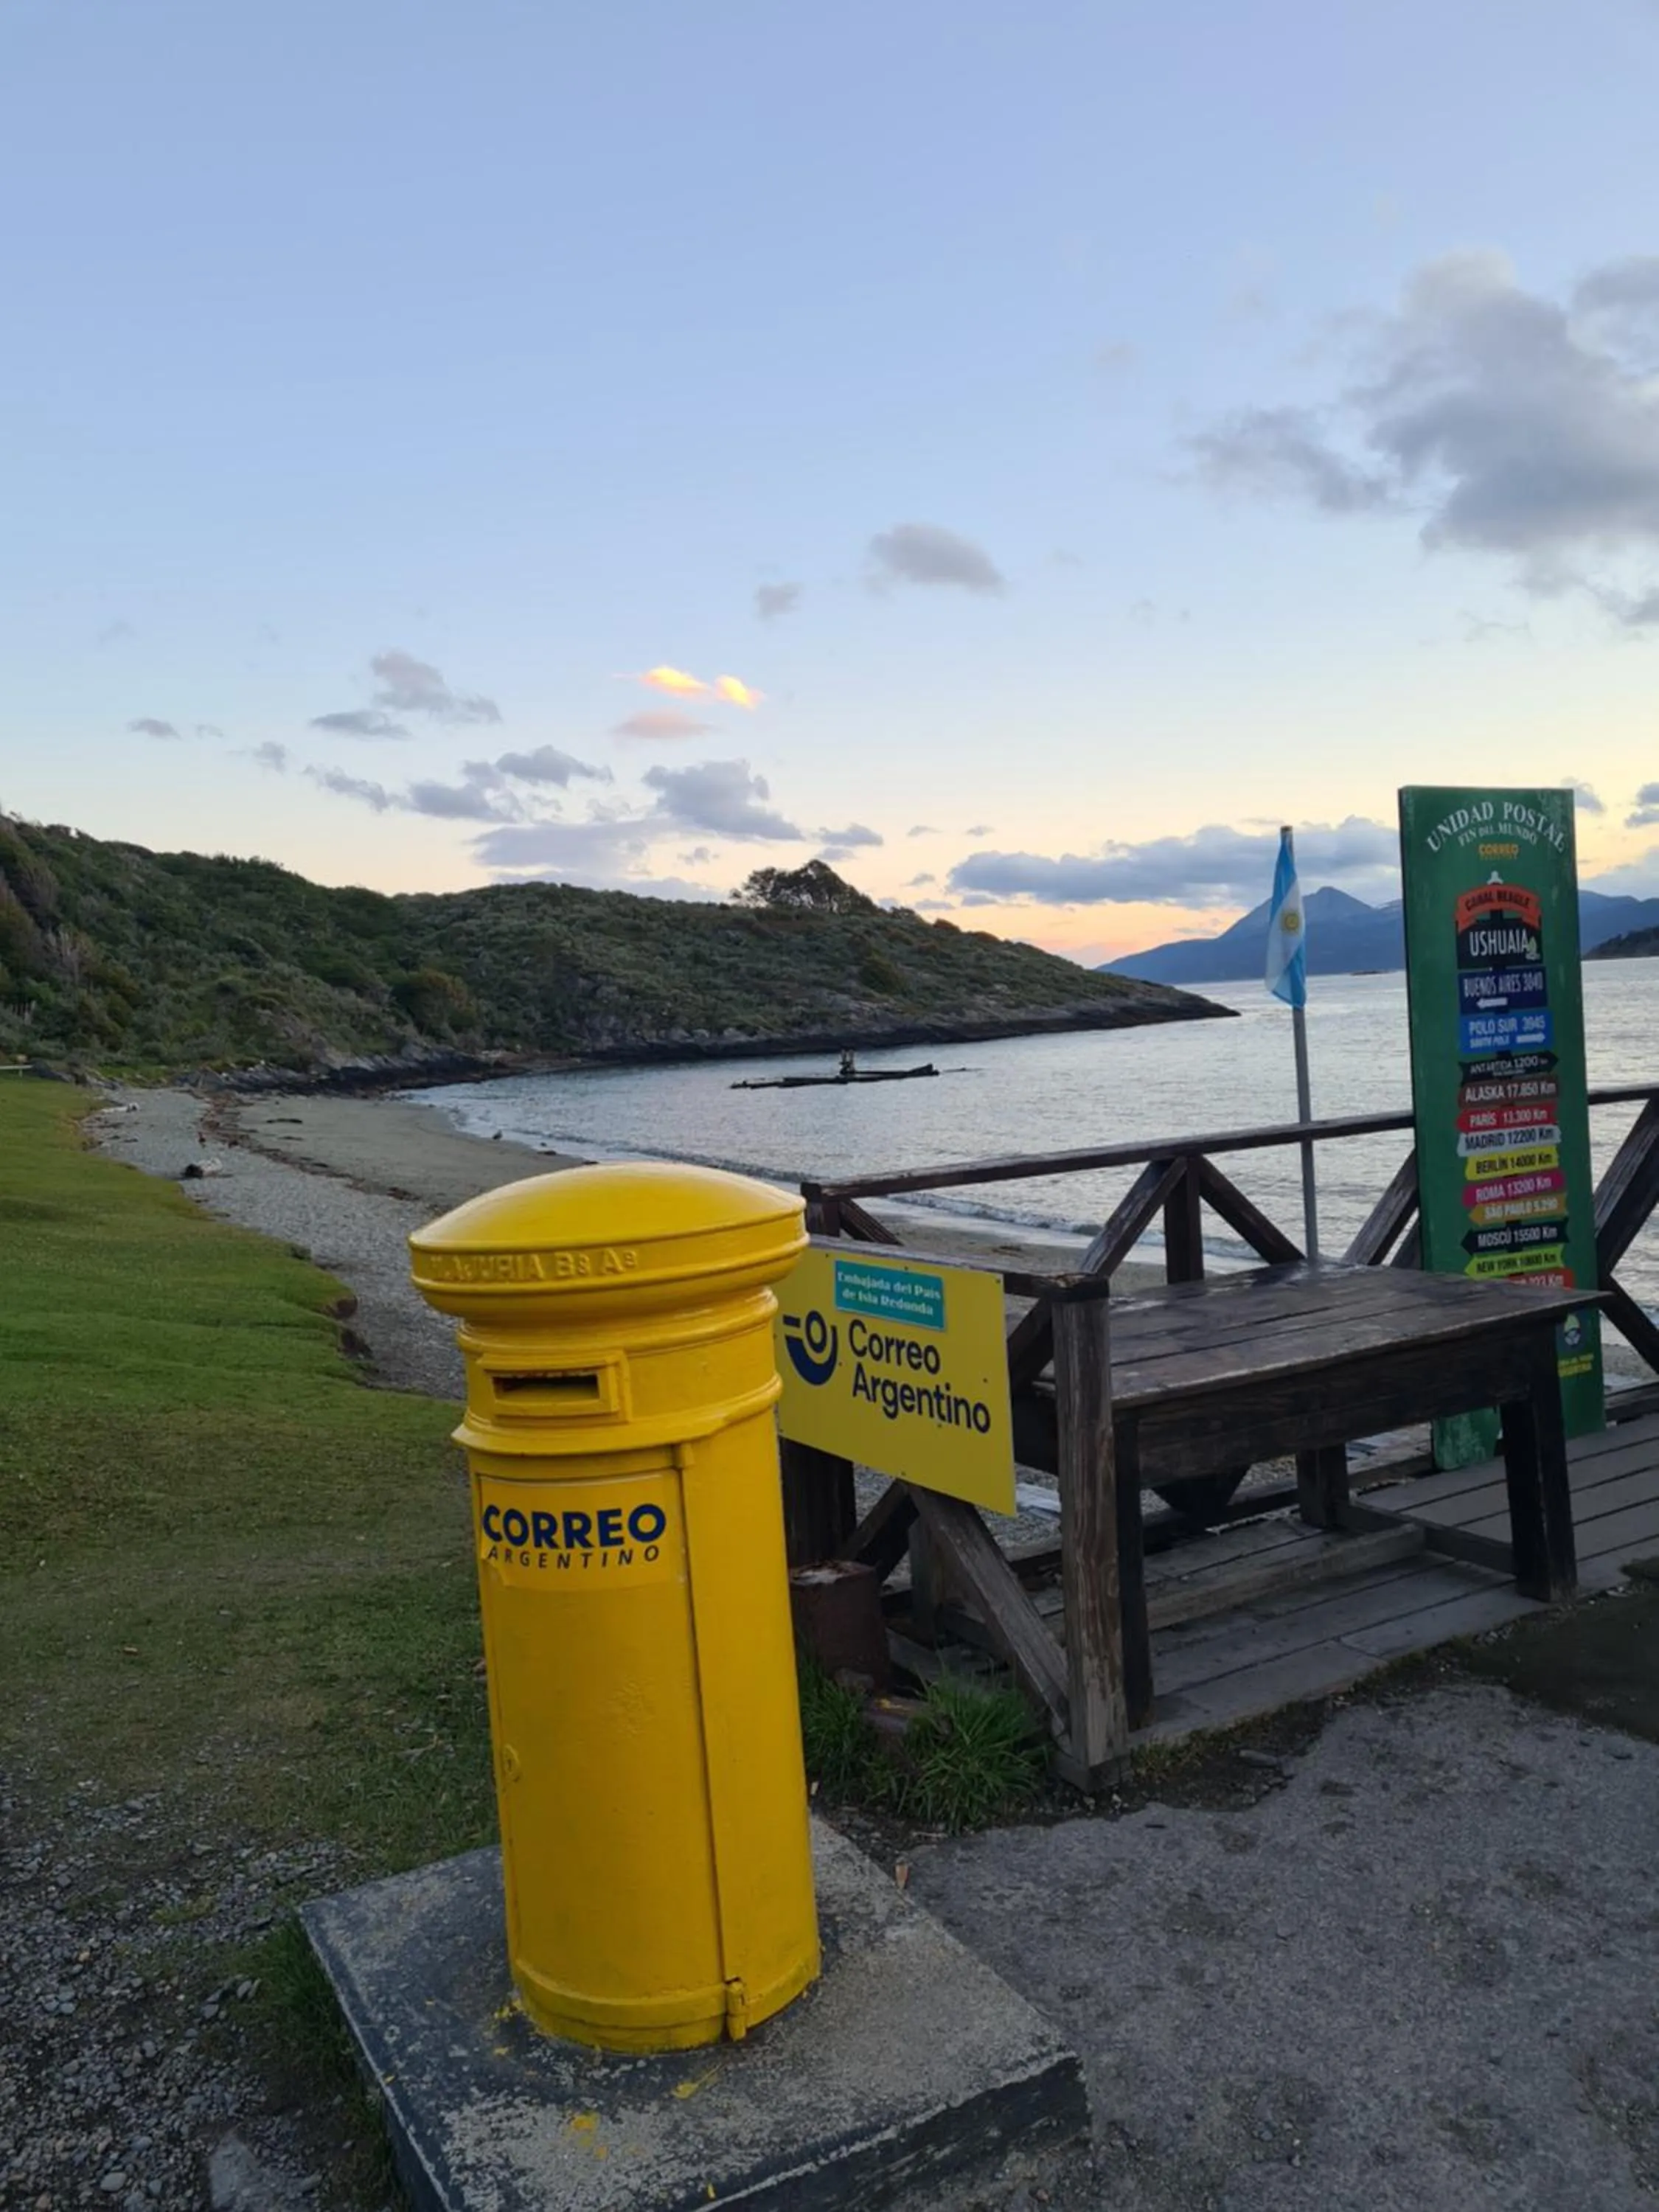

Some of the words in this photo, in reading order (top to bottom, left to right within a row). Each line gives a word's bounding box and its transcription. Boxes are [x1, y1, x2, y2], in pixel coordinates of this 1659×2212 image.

[1427, 801, 1494, 852] UNIDAD
[1503, 801, 1565, 853] POSTAL
[1498, 822, 1537, 846] MUNDO
[1469, 928, 1529, 957] USHUAIA
[1463, 975, 1497, 998] BUENOS
[1498, 973, 1521, 995] AIRES
[1469, 1018, 1496, 1037] POLO
[1497, 1016, 1518, 1034] SUR
[1465, 1084, 1506, 1103] ALASKA
[1540, 1079, 1557, 1095] Km
[1533, 1107, 1548, 1121] Km
[1465, 1132, 1506, 1150] MADRID
[1538, 1126, 1554, 1140] Km
[1538, 1152, 1552, 1165] Km
[1475, 1183, 1506, 1204] ROMA
[1536, 1175, 1552, 1192] Km
[1504, 1199, 1533, 1217] PAULO
[1542, 1225, 1558, 1239] Km
[1476, 1260, 1495, 1275] NEW
[1544, 1252, 1557, 1265] Km
[837, 1270, 891, 1291] Embajada
[892, 1281, 912, 1295] del
[841, 1287, 857, 1300] de
[858, 1290, 879, 1305] Isla
[880, 1295, 934, 1316] Redonda
[848, 1318, 941, 1375] Correo
[852, 1362, 992, 1434] Argentino
[483, 1503, 667, 1550] CORREO
[487, 1545, 660, 1570] ARGENTINO
